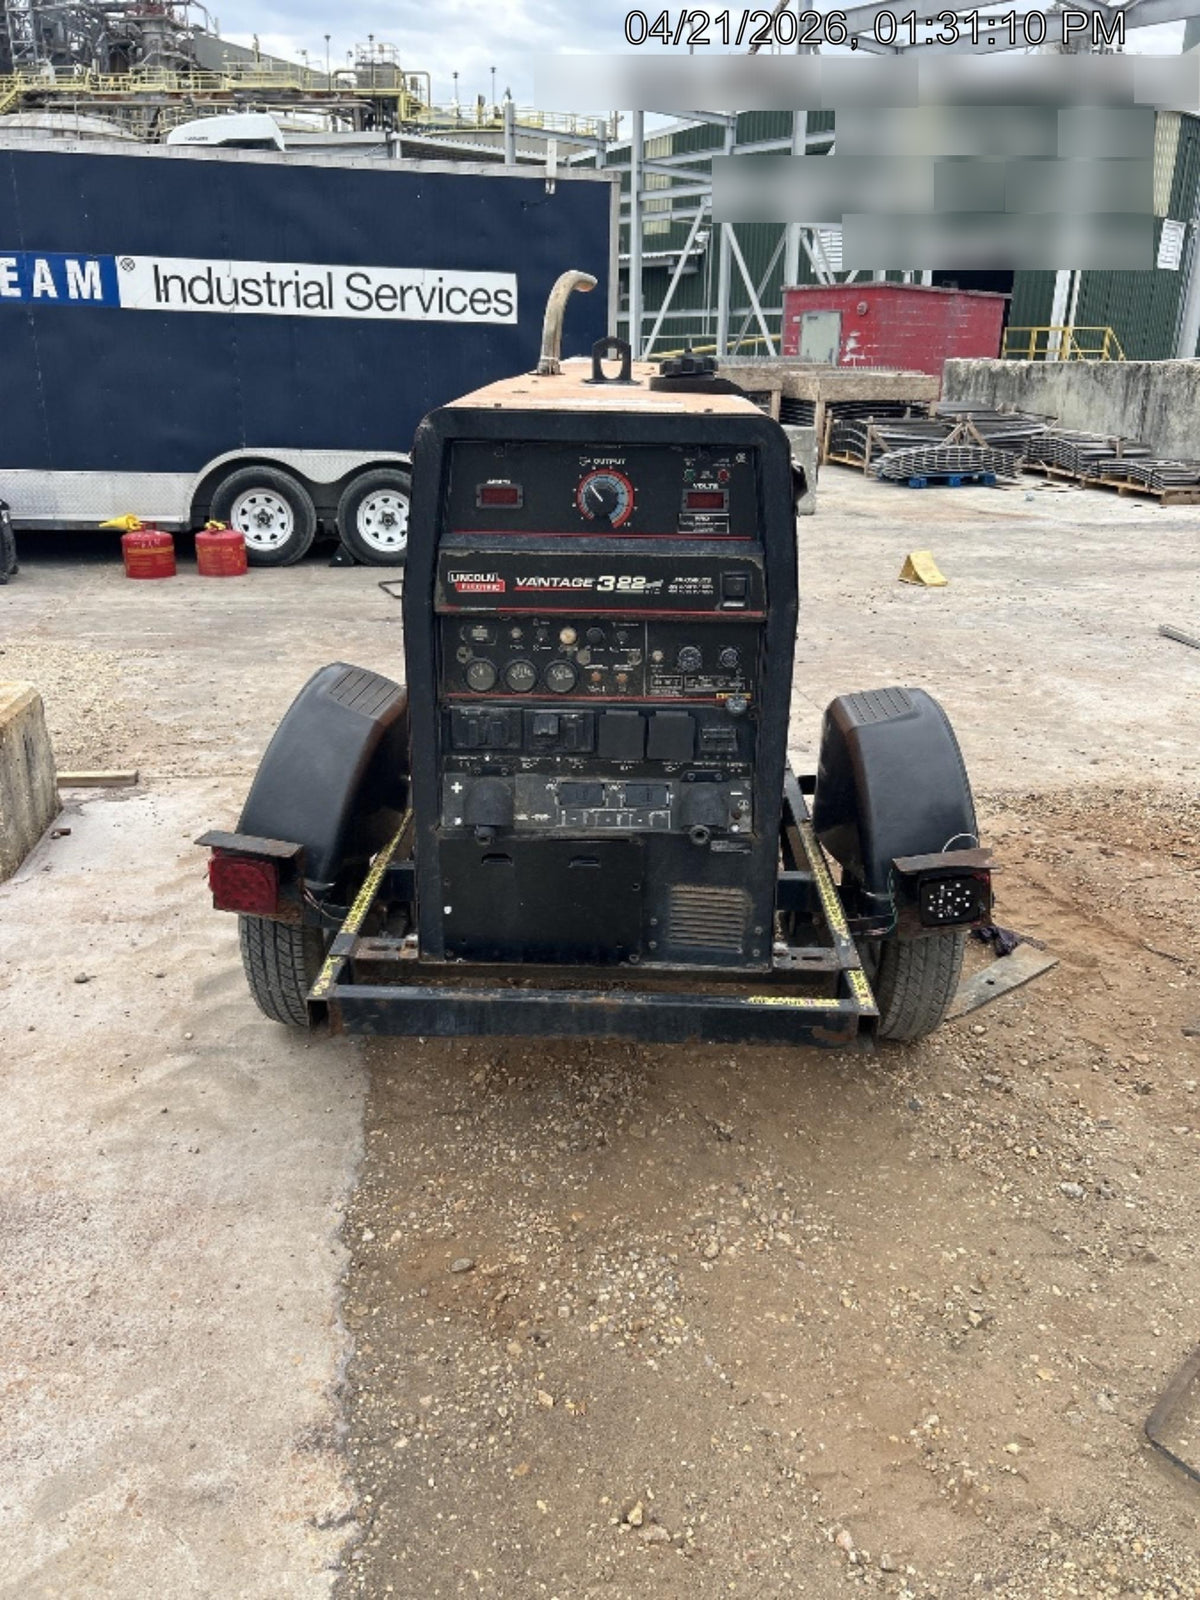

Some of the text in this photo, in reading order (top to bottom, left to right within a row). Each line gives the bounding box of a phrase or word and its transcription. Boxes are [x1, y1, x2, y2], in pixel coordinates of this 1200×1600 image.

[153, 264, 335, 310] Industrial
[345, 273, 514, 318] Services
[450, 572, 496, 582] LINCOLN
[515, 576, 594, 588] VANTAGE
[596, 575, 646, 592] 322
